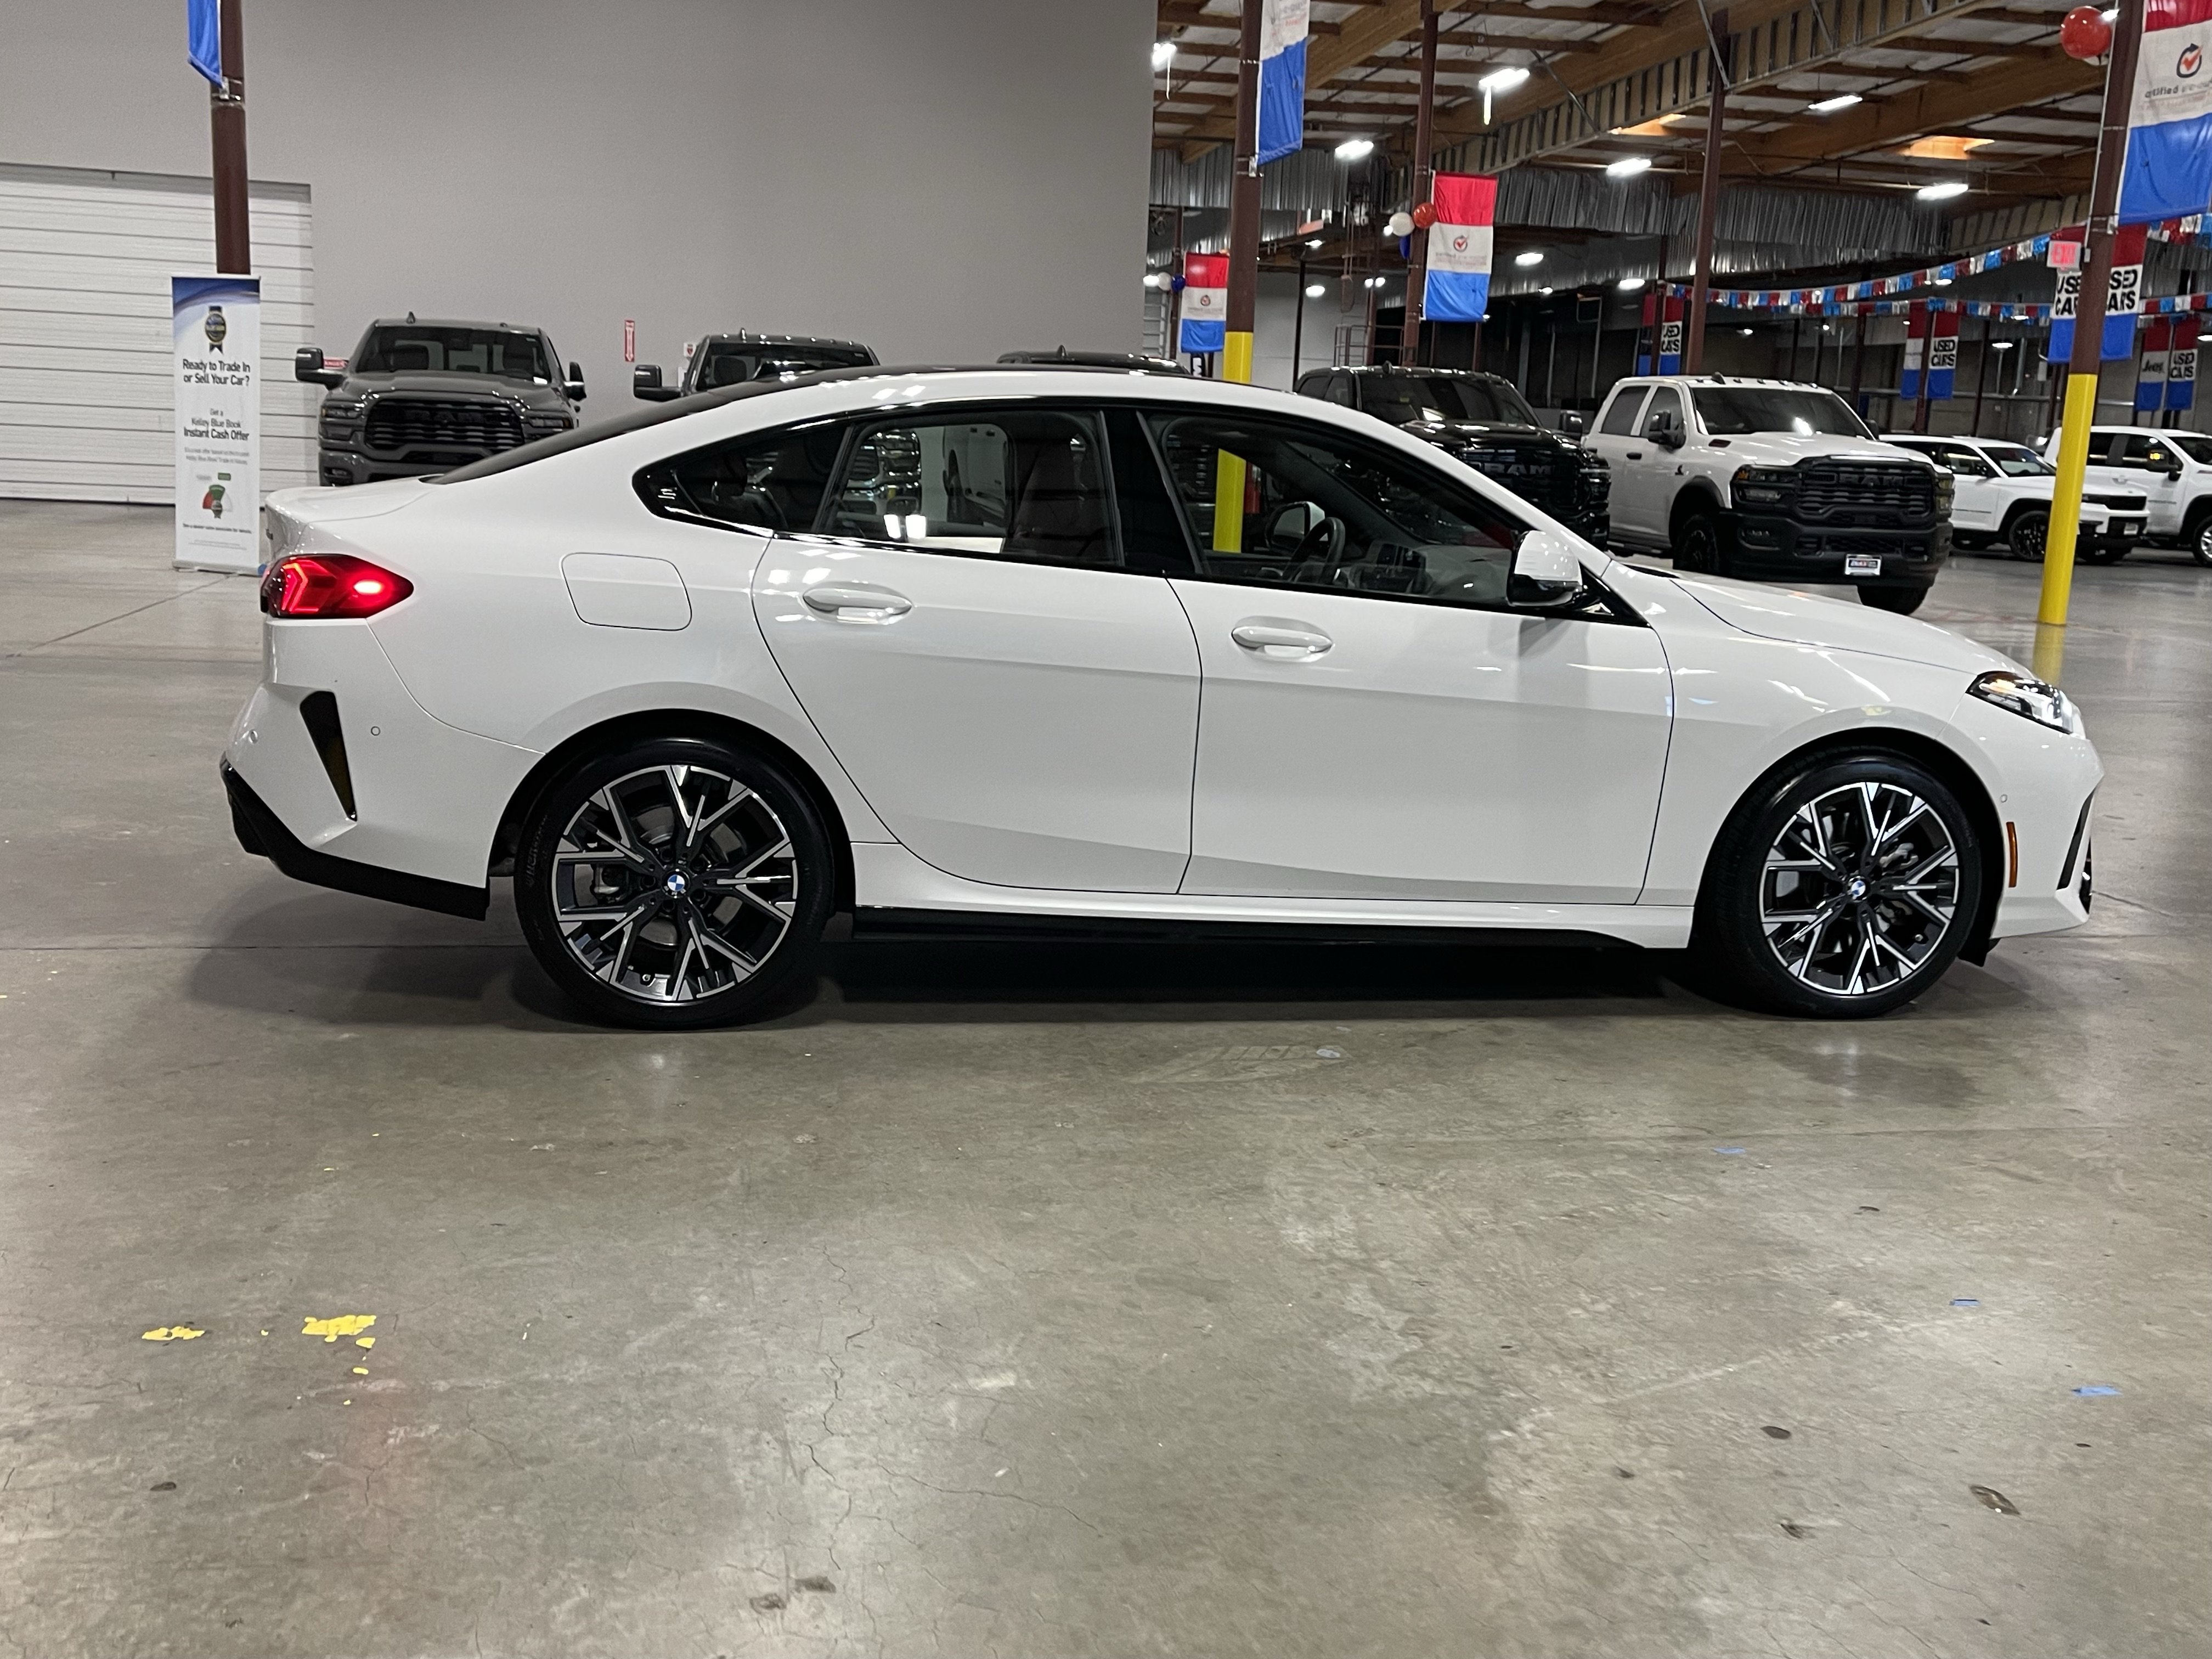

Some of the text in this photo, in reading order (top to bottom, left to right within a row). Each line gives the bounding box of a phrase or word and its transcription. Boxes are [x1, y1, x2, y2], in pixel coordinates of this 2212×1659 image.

[2057, 275, 2081, 294] USE
[2109, 269, 2138, 290] SED
[2107, 290, 2136, 312] ARS
[1934, 339, 1955, 352] USED
[183, 359, 250, 373] Ready to Trade In
[195, 373, 210, 384] Sell
[211, 374, 229, 385] Your
[184, 426, 250, 441] Instant Cash Offer
[1484, 462, 1553, 475] RAM
[1839, 473, 1904, 486] RAM
